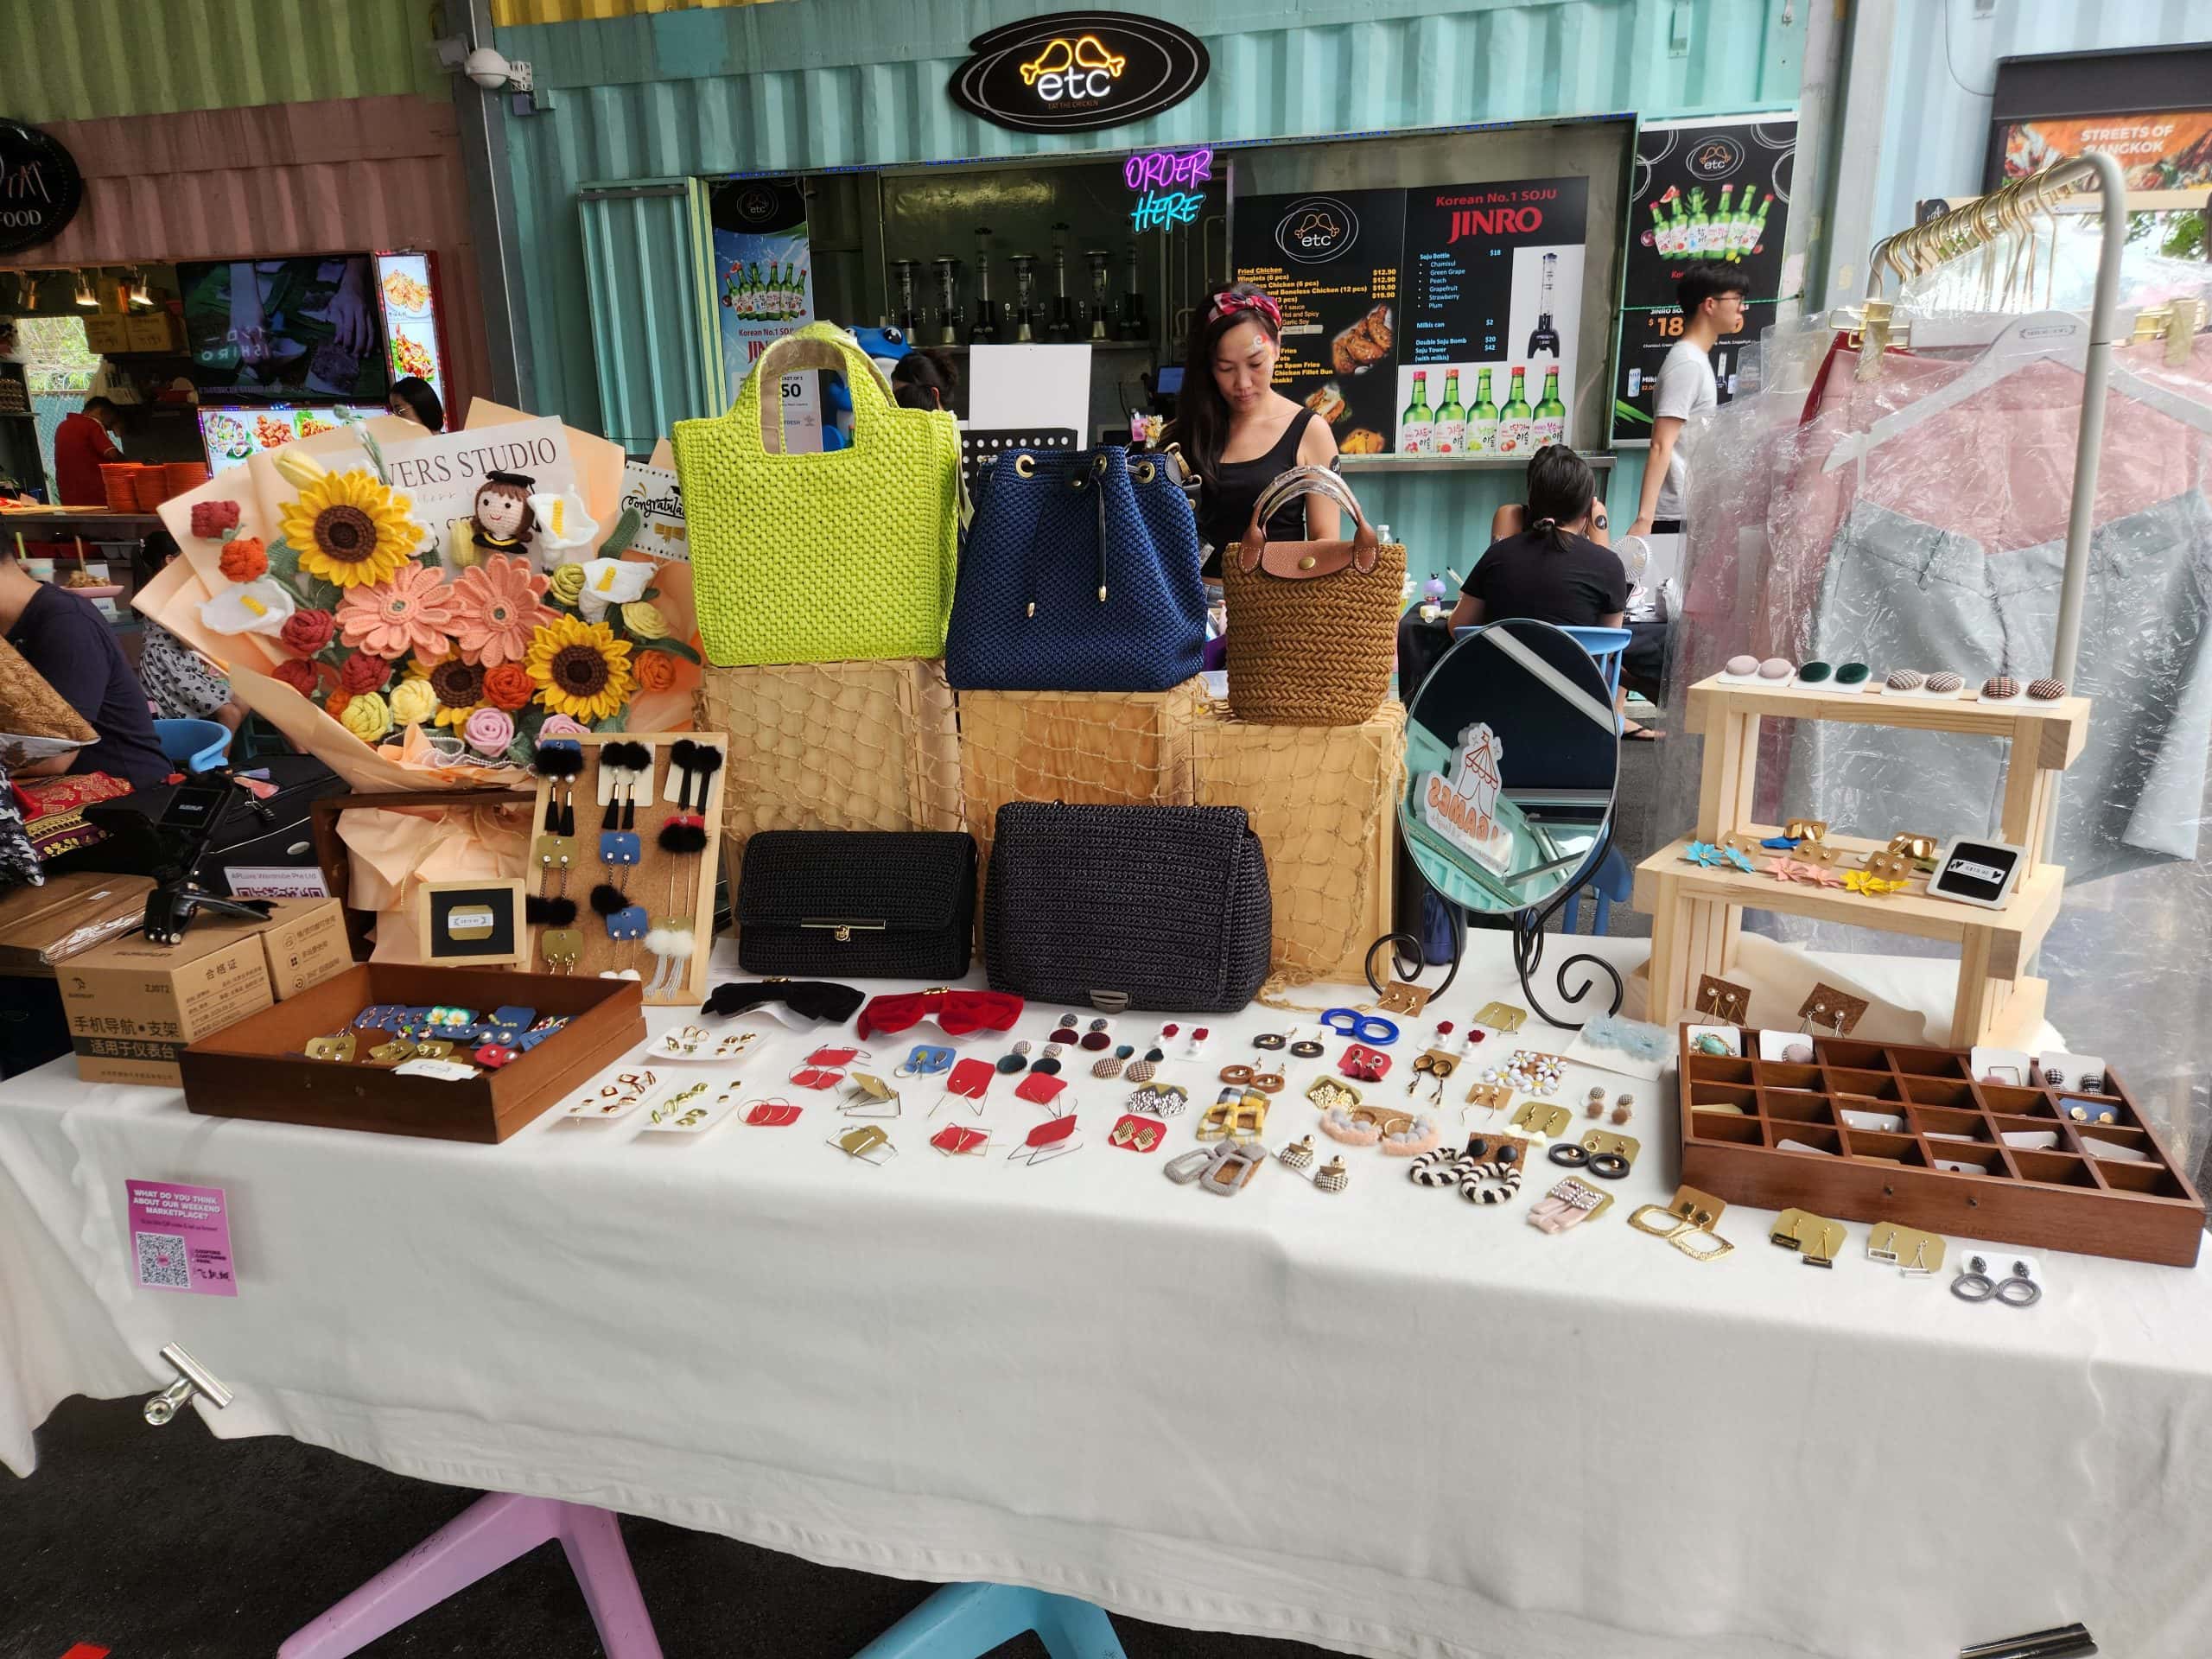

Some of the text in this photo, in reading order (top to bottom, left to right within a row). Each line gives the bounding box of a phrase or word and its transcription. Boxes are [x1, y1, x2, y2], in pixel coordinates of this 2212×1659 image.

[1037, 66, 1111, 101] etc
[2081, 124, 2174, 142] STREETS OF
[1125, 149, 1211, 192] ORDER
[1704, 160, 1726, 170] etc
[1435, 188, 1557, 207] Korean No.1 SOJU
[1130, 189, 1204, 232] HERE
[1446, 207, 1543, 245] JINRO
[1301, 233, 1332, 247] etc
[1486, 318, 1493, 327] $2
[739, 328, 762, 337] Korean
[764, 327, 778, 336] No.1
[1484, 335, 1496, 344] $20
[460, 436, 557, 479] STUDIO
[91, 1039, 175, 1059] 适用于仪表台
[133, 1198, 221, 1213] ABOUT OUR WEEKEND
[192, 1195, 217, 1204] THINK
[145, 1206, 209, 1220] MARKETPLACE?
